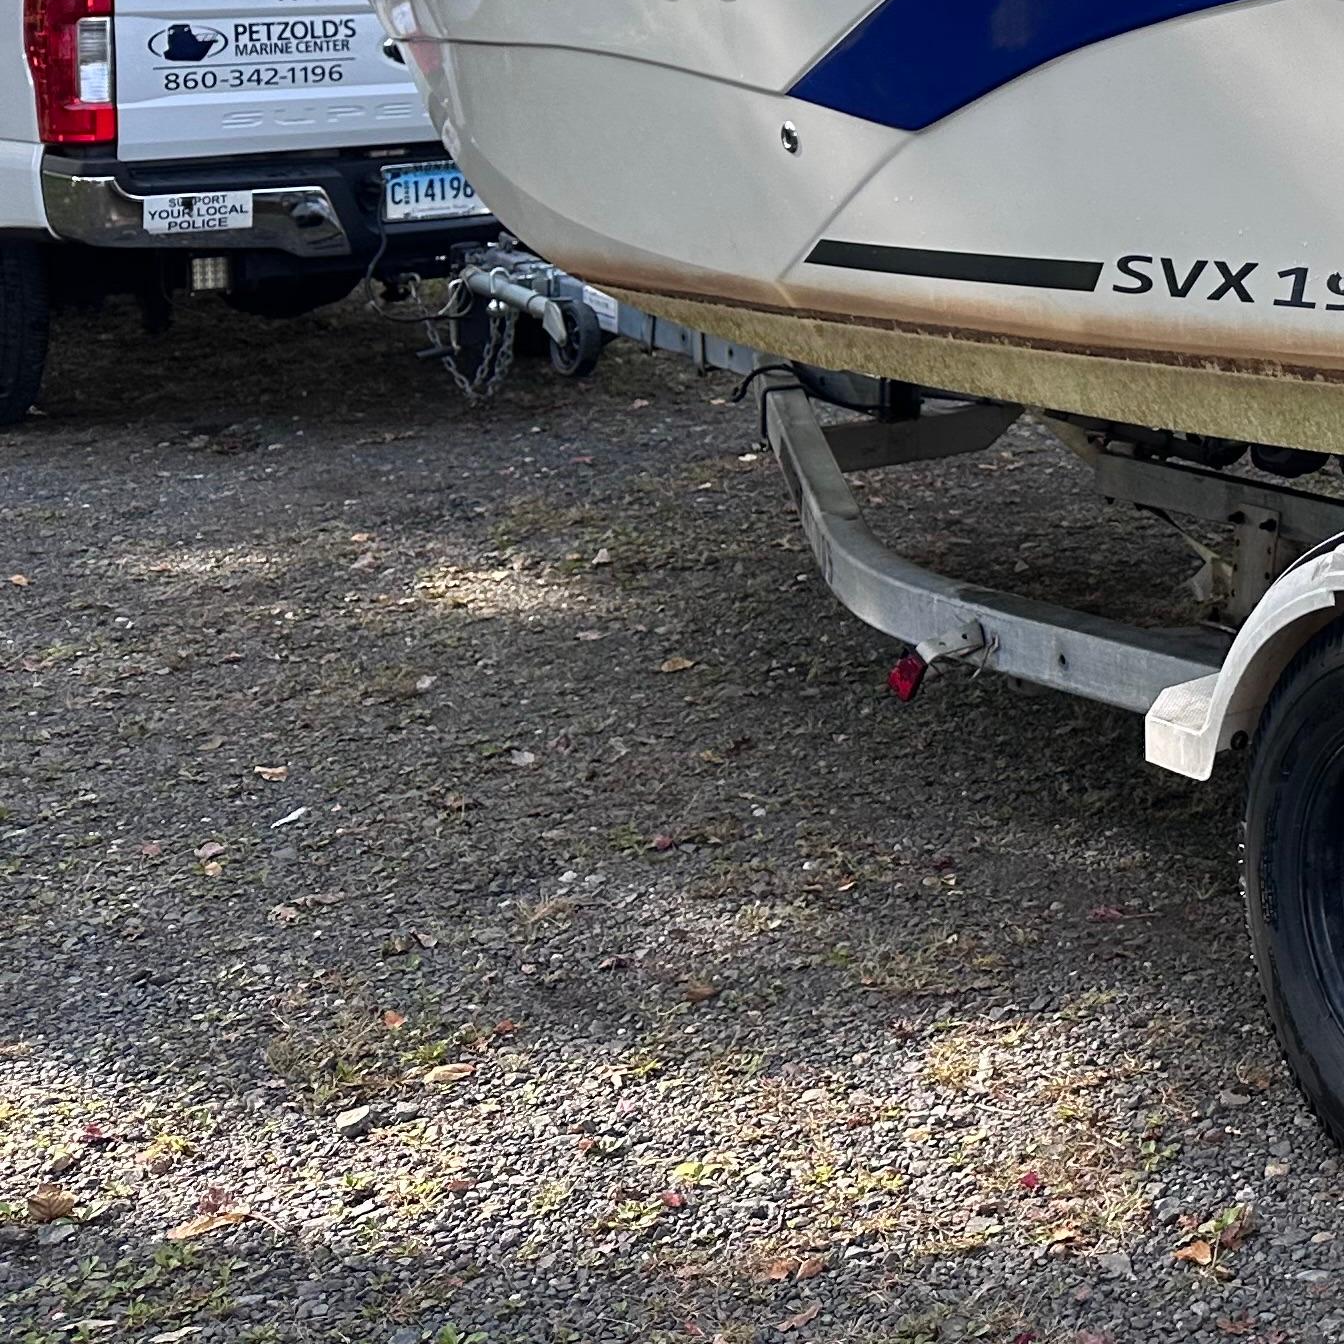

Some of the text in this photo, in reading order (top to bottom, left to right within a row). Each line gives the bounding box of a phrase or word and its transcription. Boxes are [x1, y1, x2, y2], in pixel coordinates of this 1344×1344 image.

[234, 19, 357, 42] PETZOLD'S
[235, 39, 351, 57] MARINE CENTER
[164, 64, 344, 91] 860-342-1196
[221, 102, 428, 129] SUPE
[168, 194, 228, 208] SUPORT
[148, 204, 249, 221] YOUR LOCAL
[167, 216, 229, 231] POLICE
[1112, 255, 1259, 304] SVX
